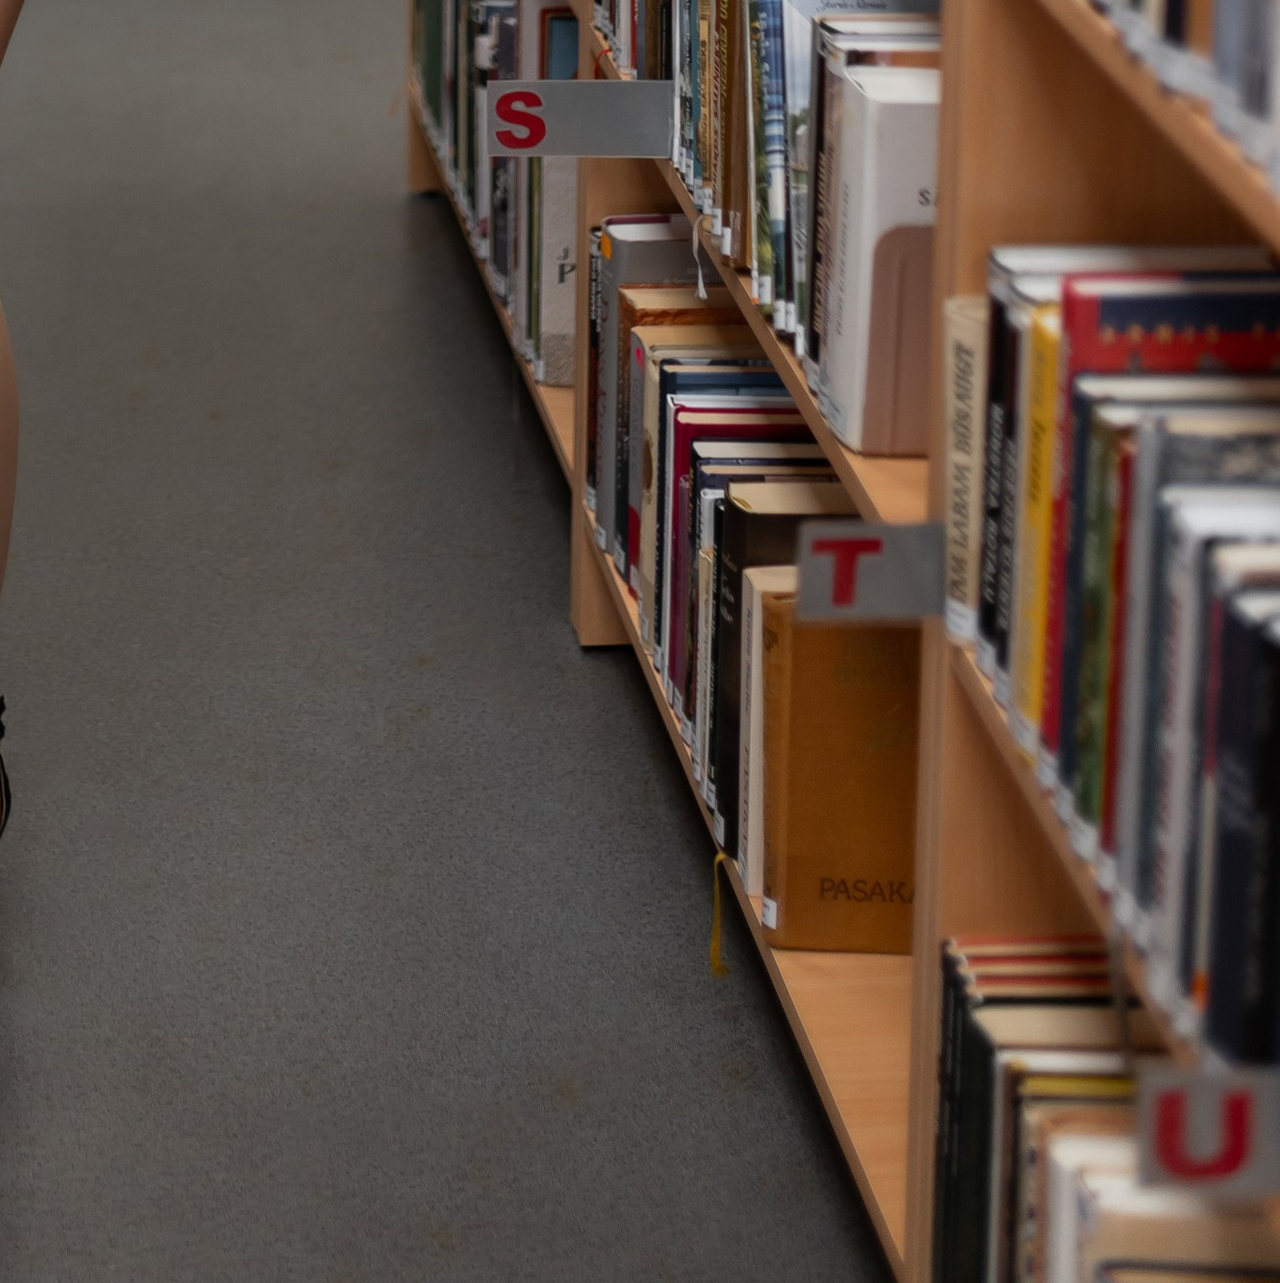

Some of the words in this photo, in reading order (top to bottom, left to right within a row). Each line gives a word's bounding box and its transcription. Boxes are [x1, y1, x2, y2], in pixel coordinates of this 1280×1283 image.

[496, 91, 546, 148] S
[918, 188, 935, 207] S
[813, 538, 882, 607] T
[819, 877, 914, 904] PASAK
[1153, 1089, 1254, 1182] U
